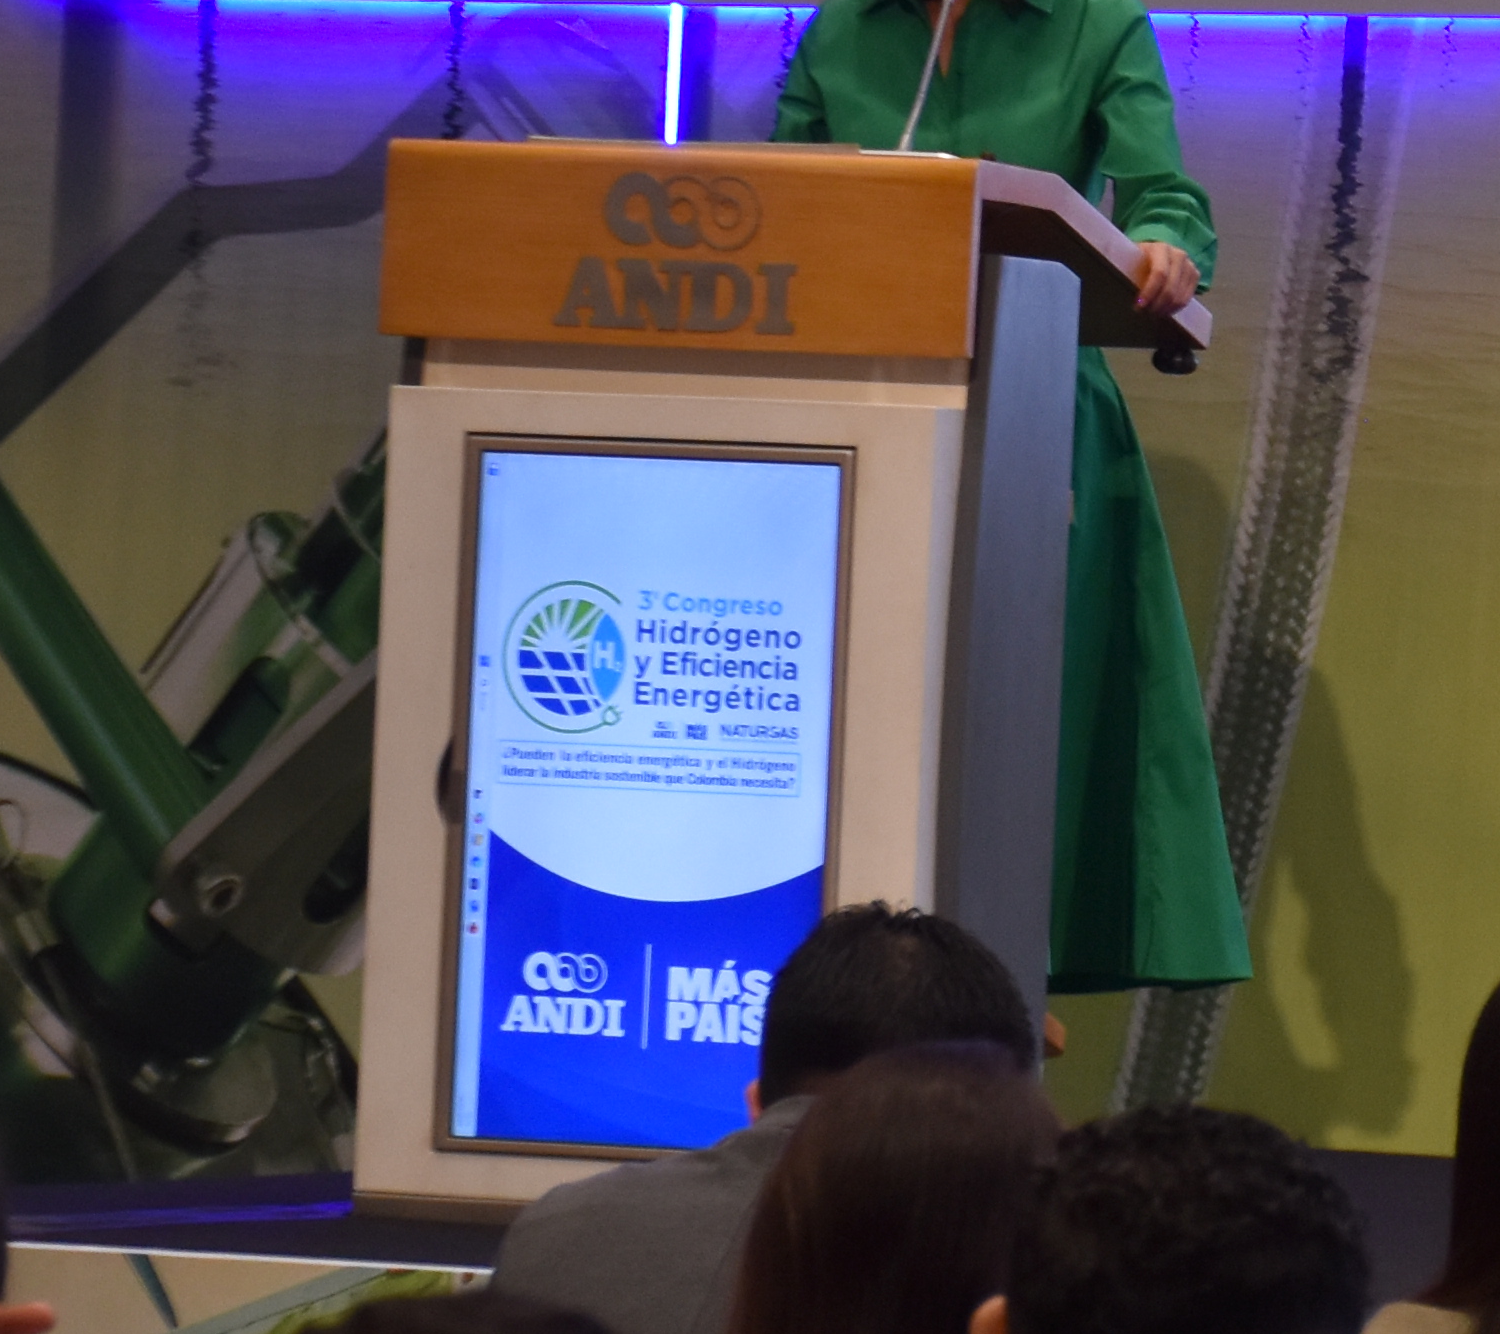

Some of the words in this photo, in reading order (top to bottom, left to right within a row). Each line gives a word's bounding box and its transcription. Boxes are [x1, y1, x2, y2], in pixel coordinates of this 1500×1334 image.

[554, 256, 797, 335] ANDI
[663, 592, 784, 618] Congreso
[636, 618, 802, 652] Hidrógeno
[634, 655, 651, 679] y
[661, 651, 798, 681] Eficiencia
[634, 681, 801, 713] Energética
[667, 960, 773, 1005] MÁS
[501, 994, 626, 1037] ANDI
